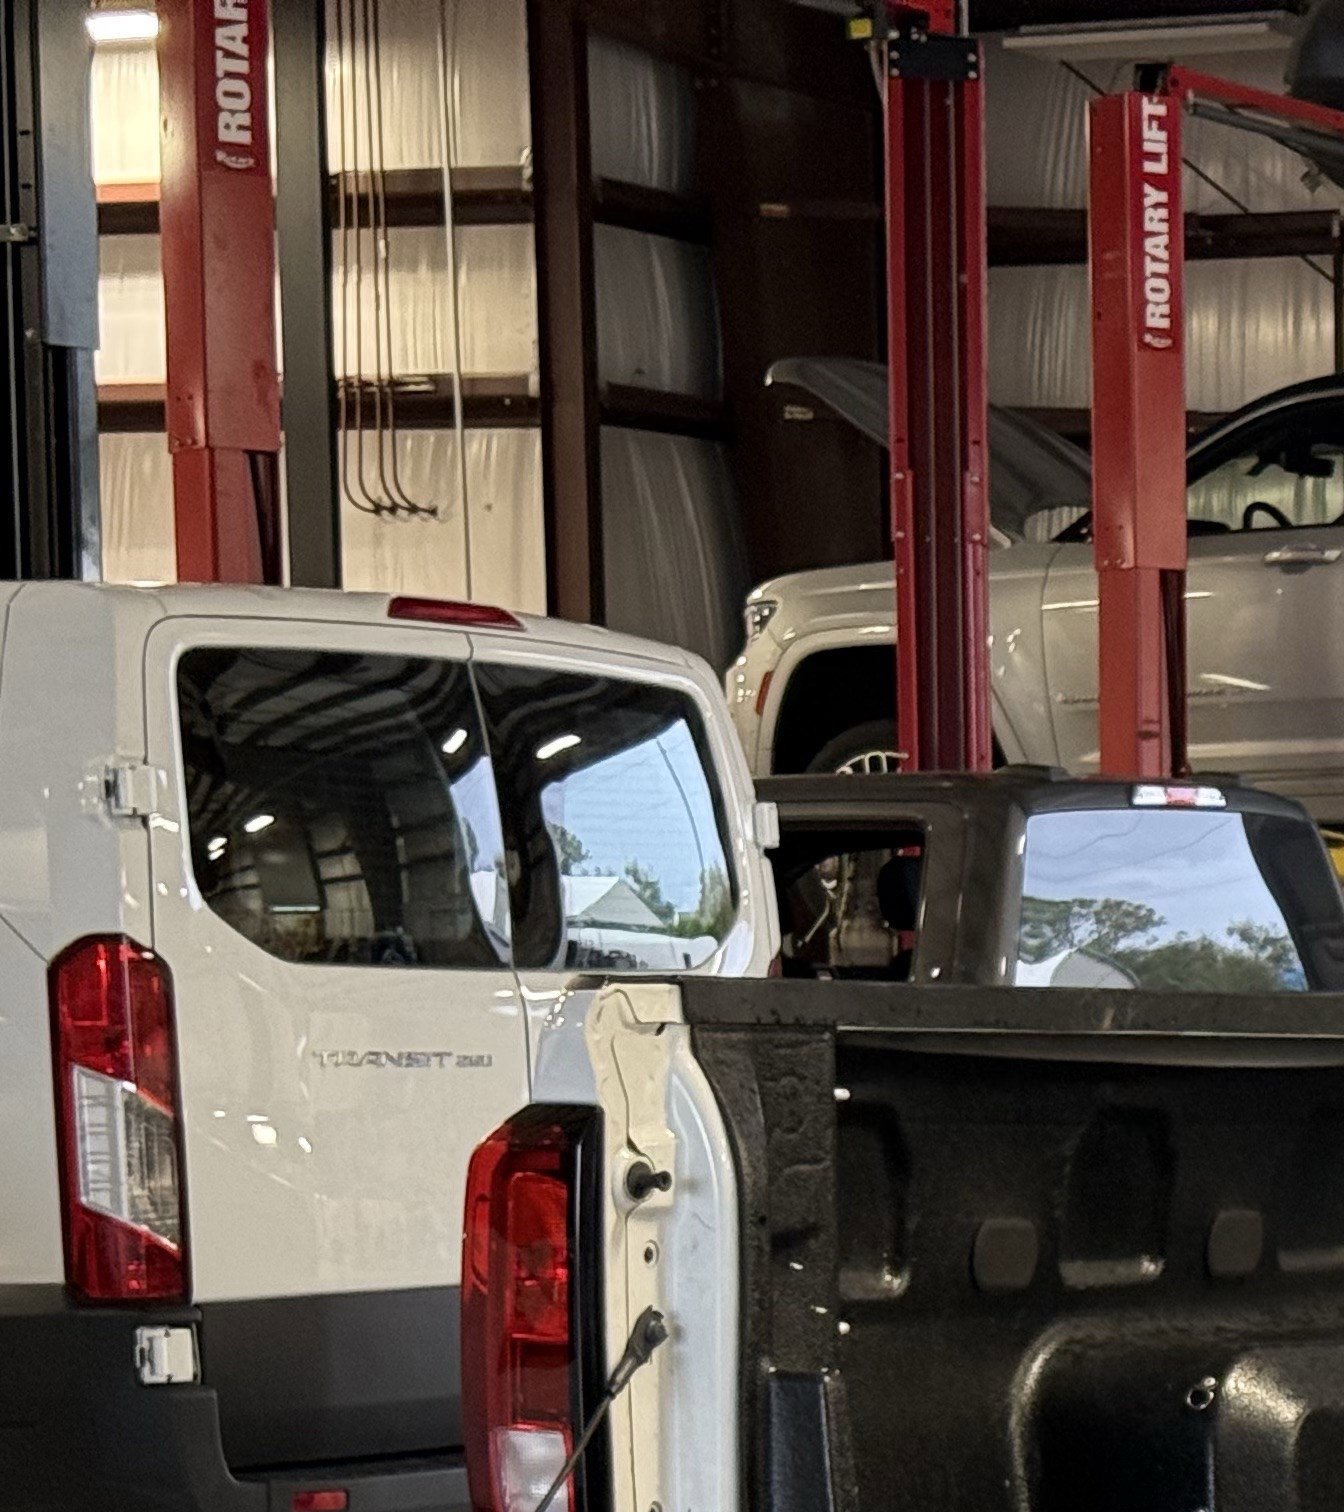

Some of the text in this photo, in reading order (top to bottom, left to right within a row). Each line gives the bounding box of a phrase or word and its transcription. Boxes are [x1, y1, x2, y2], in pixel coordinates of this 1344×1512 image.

[214, 0, 252, 145] ROTAR
[1142, 95, 1171, 329] ROTARY LIFT
